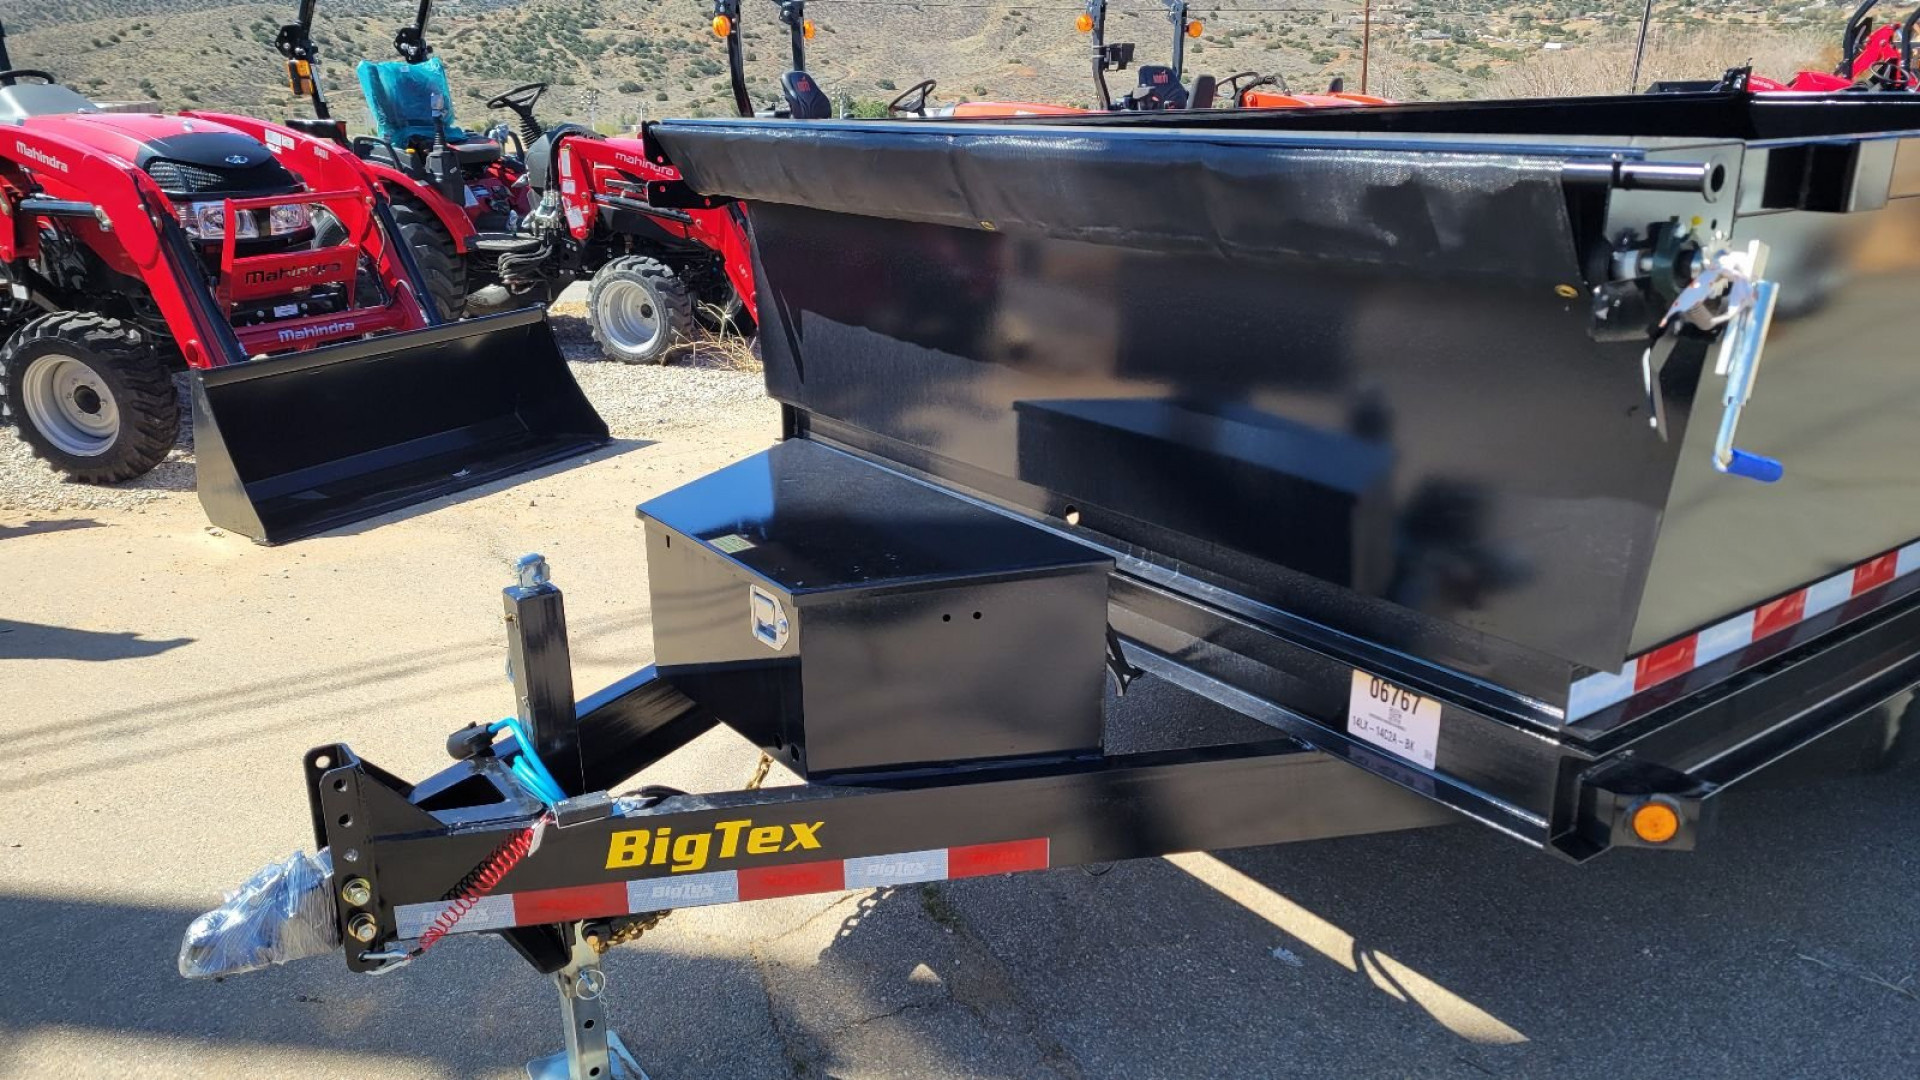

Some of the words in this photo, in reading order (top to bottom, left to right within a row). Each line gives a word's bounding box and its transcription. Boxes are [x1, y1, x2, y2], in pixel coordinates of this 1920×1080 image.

[1369, 677, 1421, 715] 06767
[605, 819, 825, 872] BigTex
[651, 883, 715, 900] BigTex
